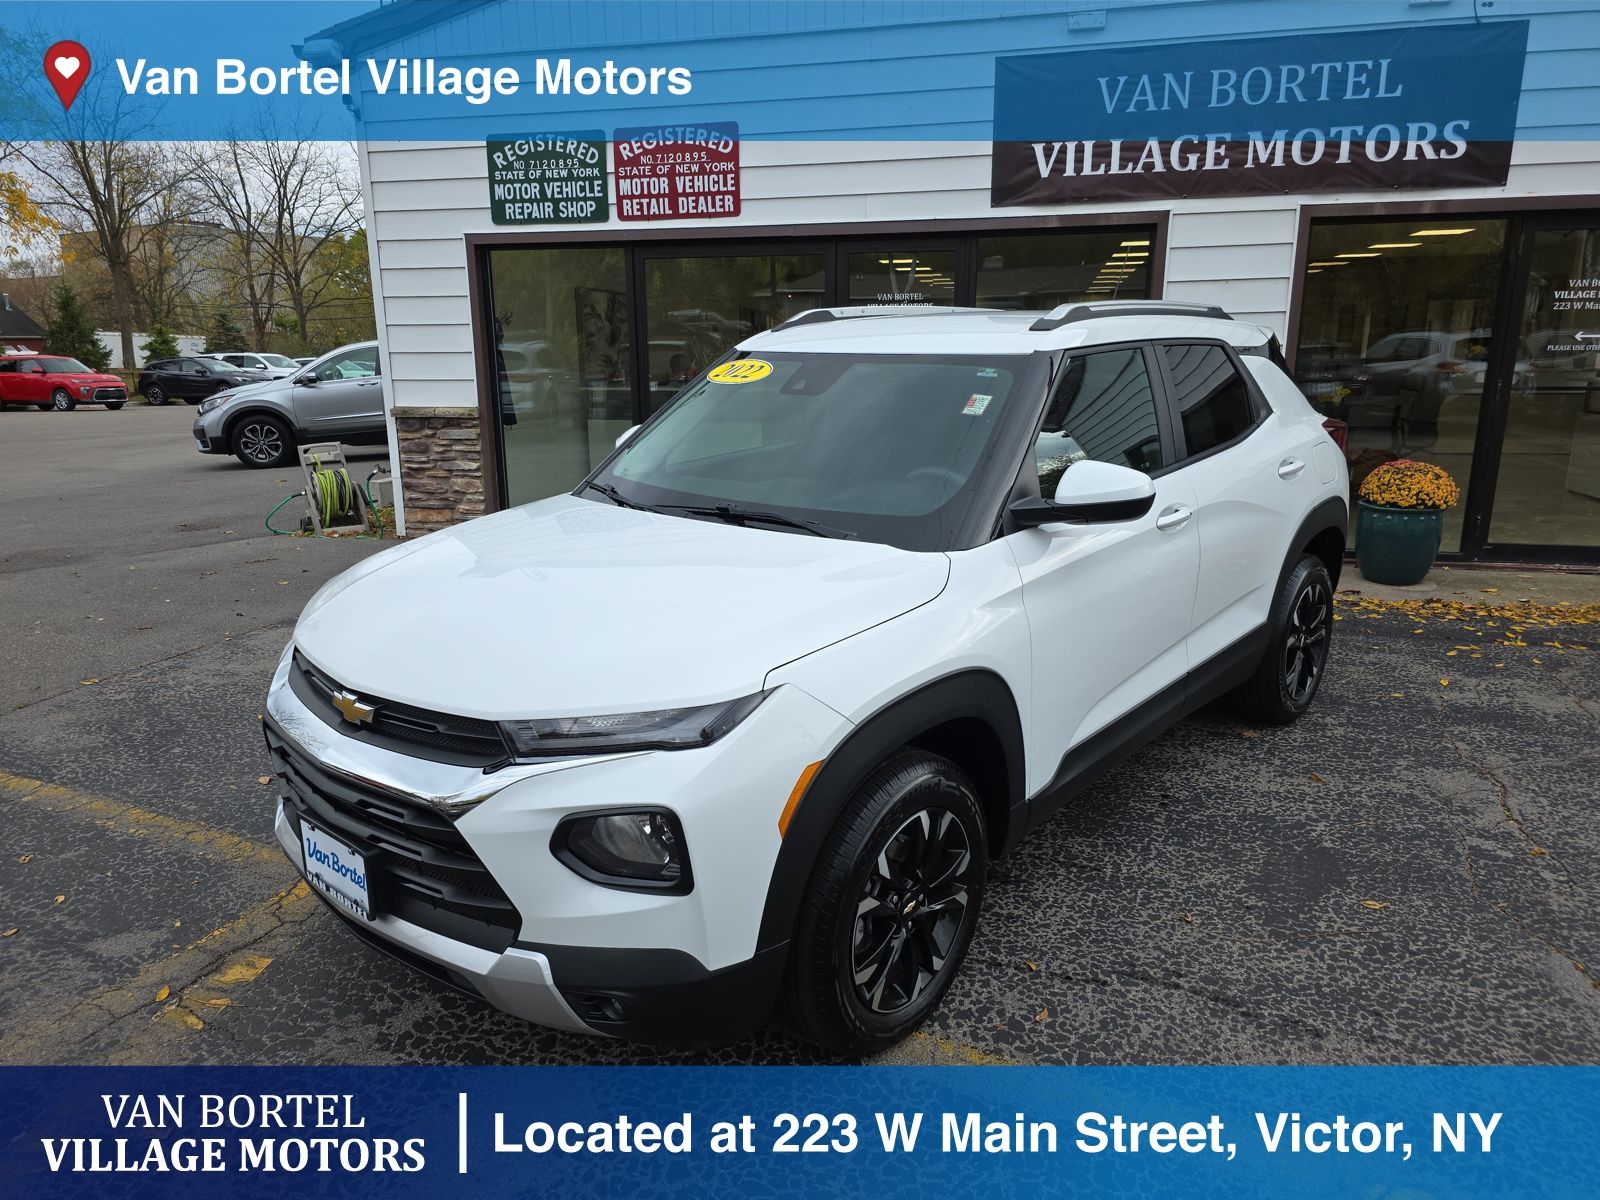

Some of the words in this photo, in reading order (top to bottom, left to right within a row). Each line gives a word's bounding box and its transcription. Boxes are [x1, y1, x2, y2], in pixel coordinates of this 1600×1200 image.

[1097, 71, 1194, 114] VAN
[1207, 58, 1403, 109] BORTEL
[492, 133, 600, 169] REGISTERED
[618, 126, 735, 161] REGISTERED
[1031, 132, 1232, 179] VILLAGE
[1243, 119, 1471, 169] MOTORS
[529, 157, 580, 170] 7120895
[656, 151, 708, 163] 7120895
[494, 170, 526, 181] STATE
[528, 169, 543, 180] OF
[545, 168, 569, 180] NEW
[572, 167, 601, 178] YORK
[618, 165, 652, 177] STATE
[656, 164, 672, 175] OF
[675, 163, 700, 174] NEW
[703, 161, 736, 173] YORK
[494, 182, 541, 201] MOTOR
[543, 180, 604, 199] VEHICLE
[619, 177, 670, 197] MOTOR
[675, 173, 737, 194] VEHICLE
[505, 202, 555, 220] REPAIR
[559, 200, 597, 218] SHOP
[622, 197, 673, 217] RETAIL
[678, 194, 735, 215] DEALER
[1569, 279, 1590, 288] VAN
[877, 293, 893, 301] VAN
[894, 292, 924, 301] BORTEL
[1554, 290, 1597, 299] VILLAGE
[1553, 301, 1571, 310] 223
[1573, 301, 1584, 310] W
[712, 363, 765, 378] 2022
